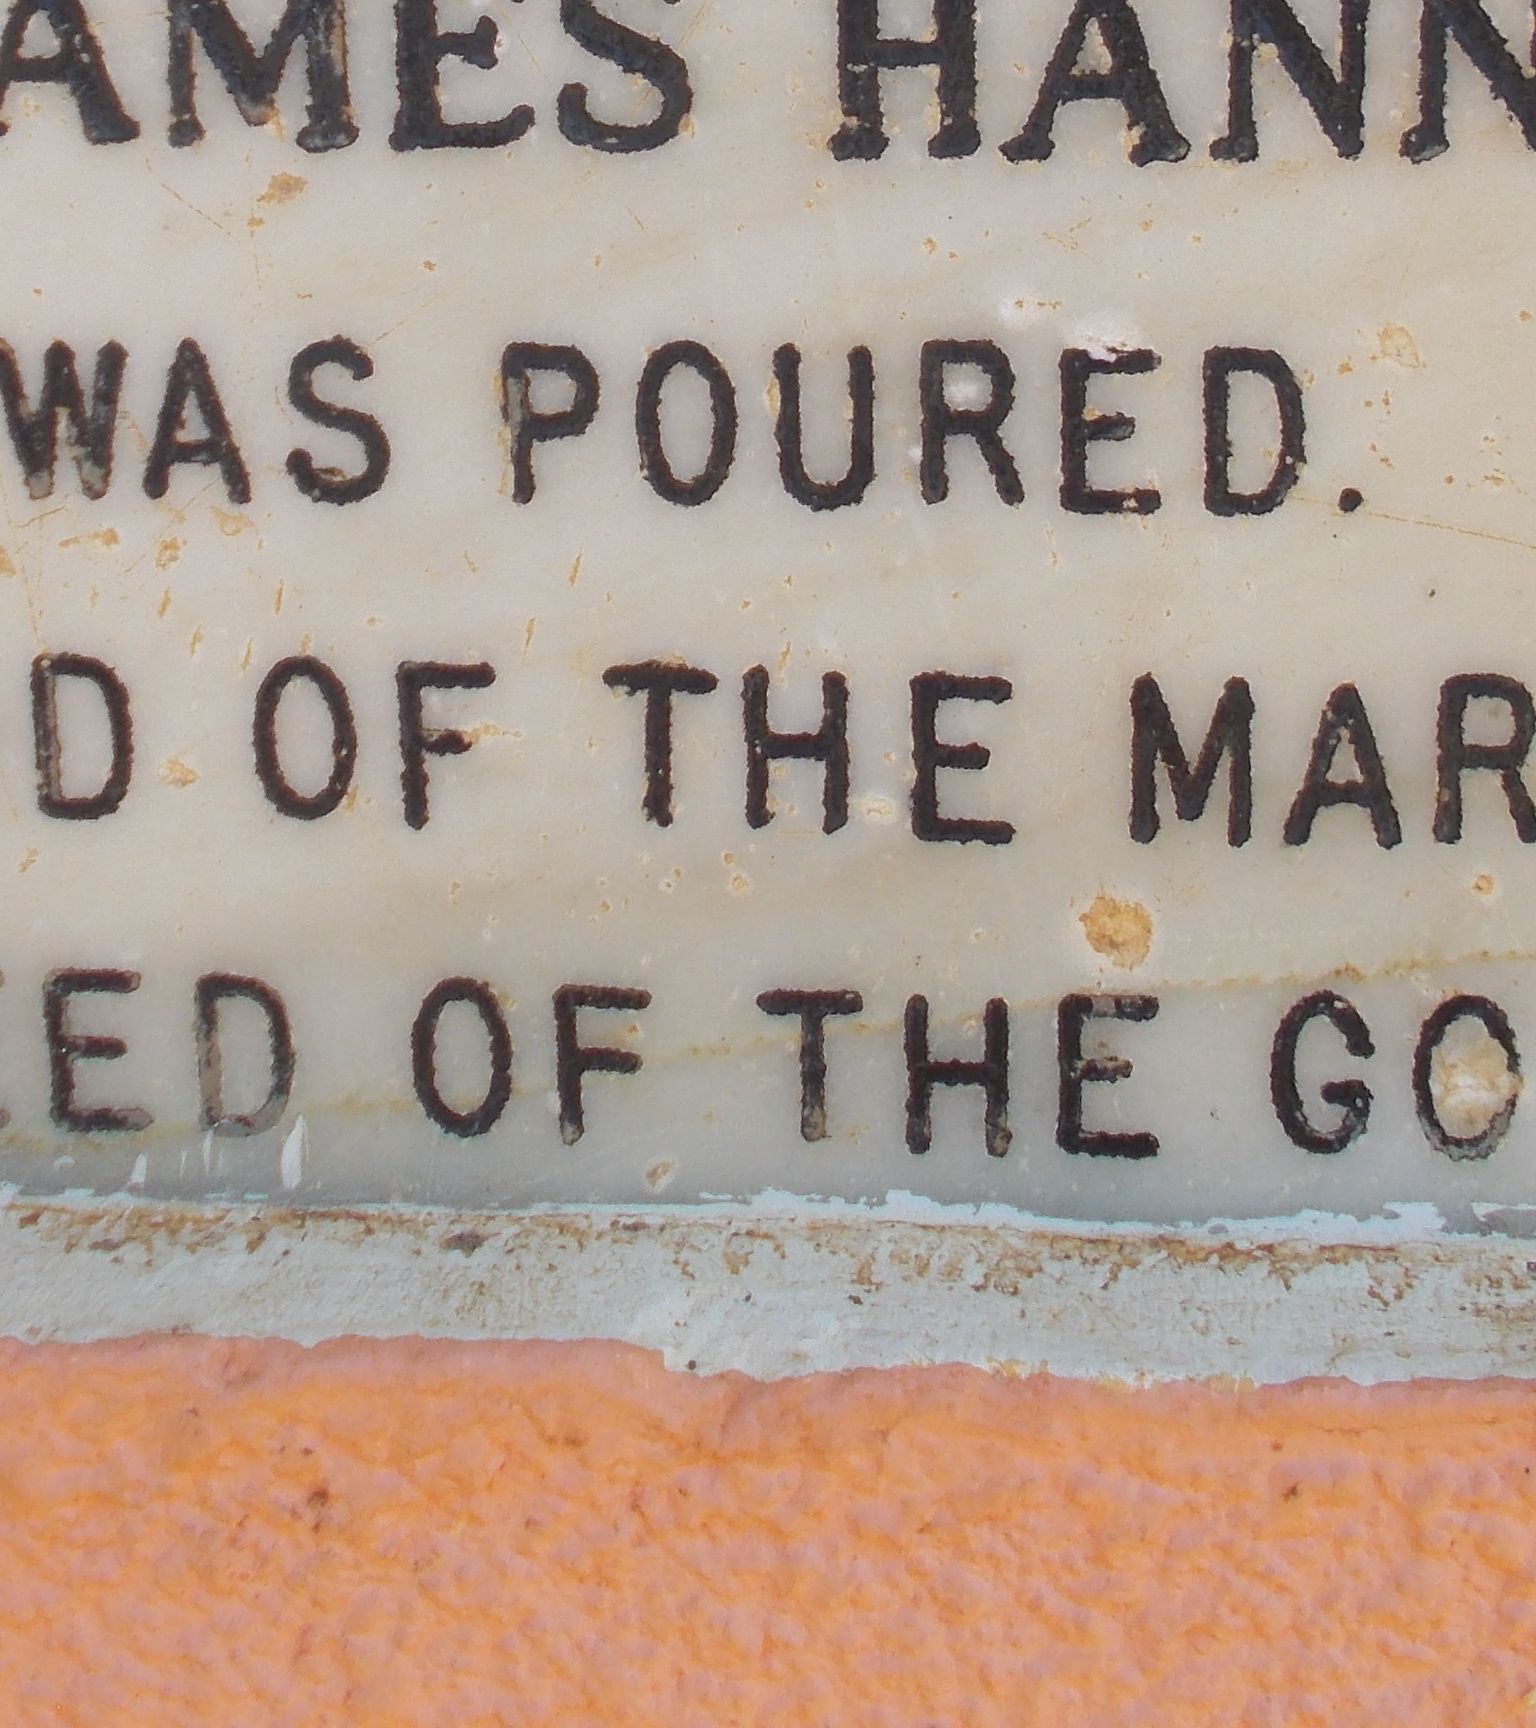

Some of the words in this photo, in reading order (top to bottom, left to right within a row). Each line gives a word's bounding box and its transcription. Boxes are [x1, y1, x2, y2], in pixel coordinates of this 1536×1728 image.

[498, 336, 1364, 517] POURED.
[251, 654, 497, 831] OF
[602, 659, 1017, 847] THE
[410, 976, 652, 1146] OF
[756, 988, 1160, 1161] THE
